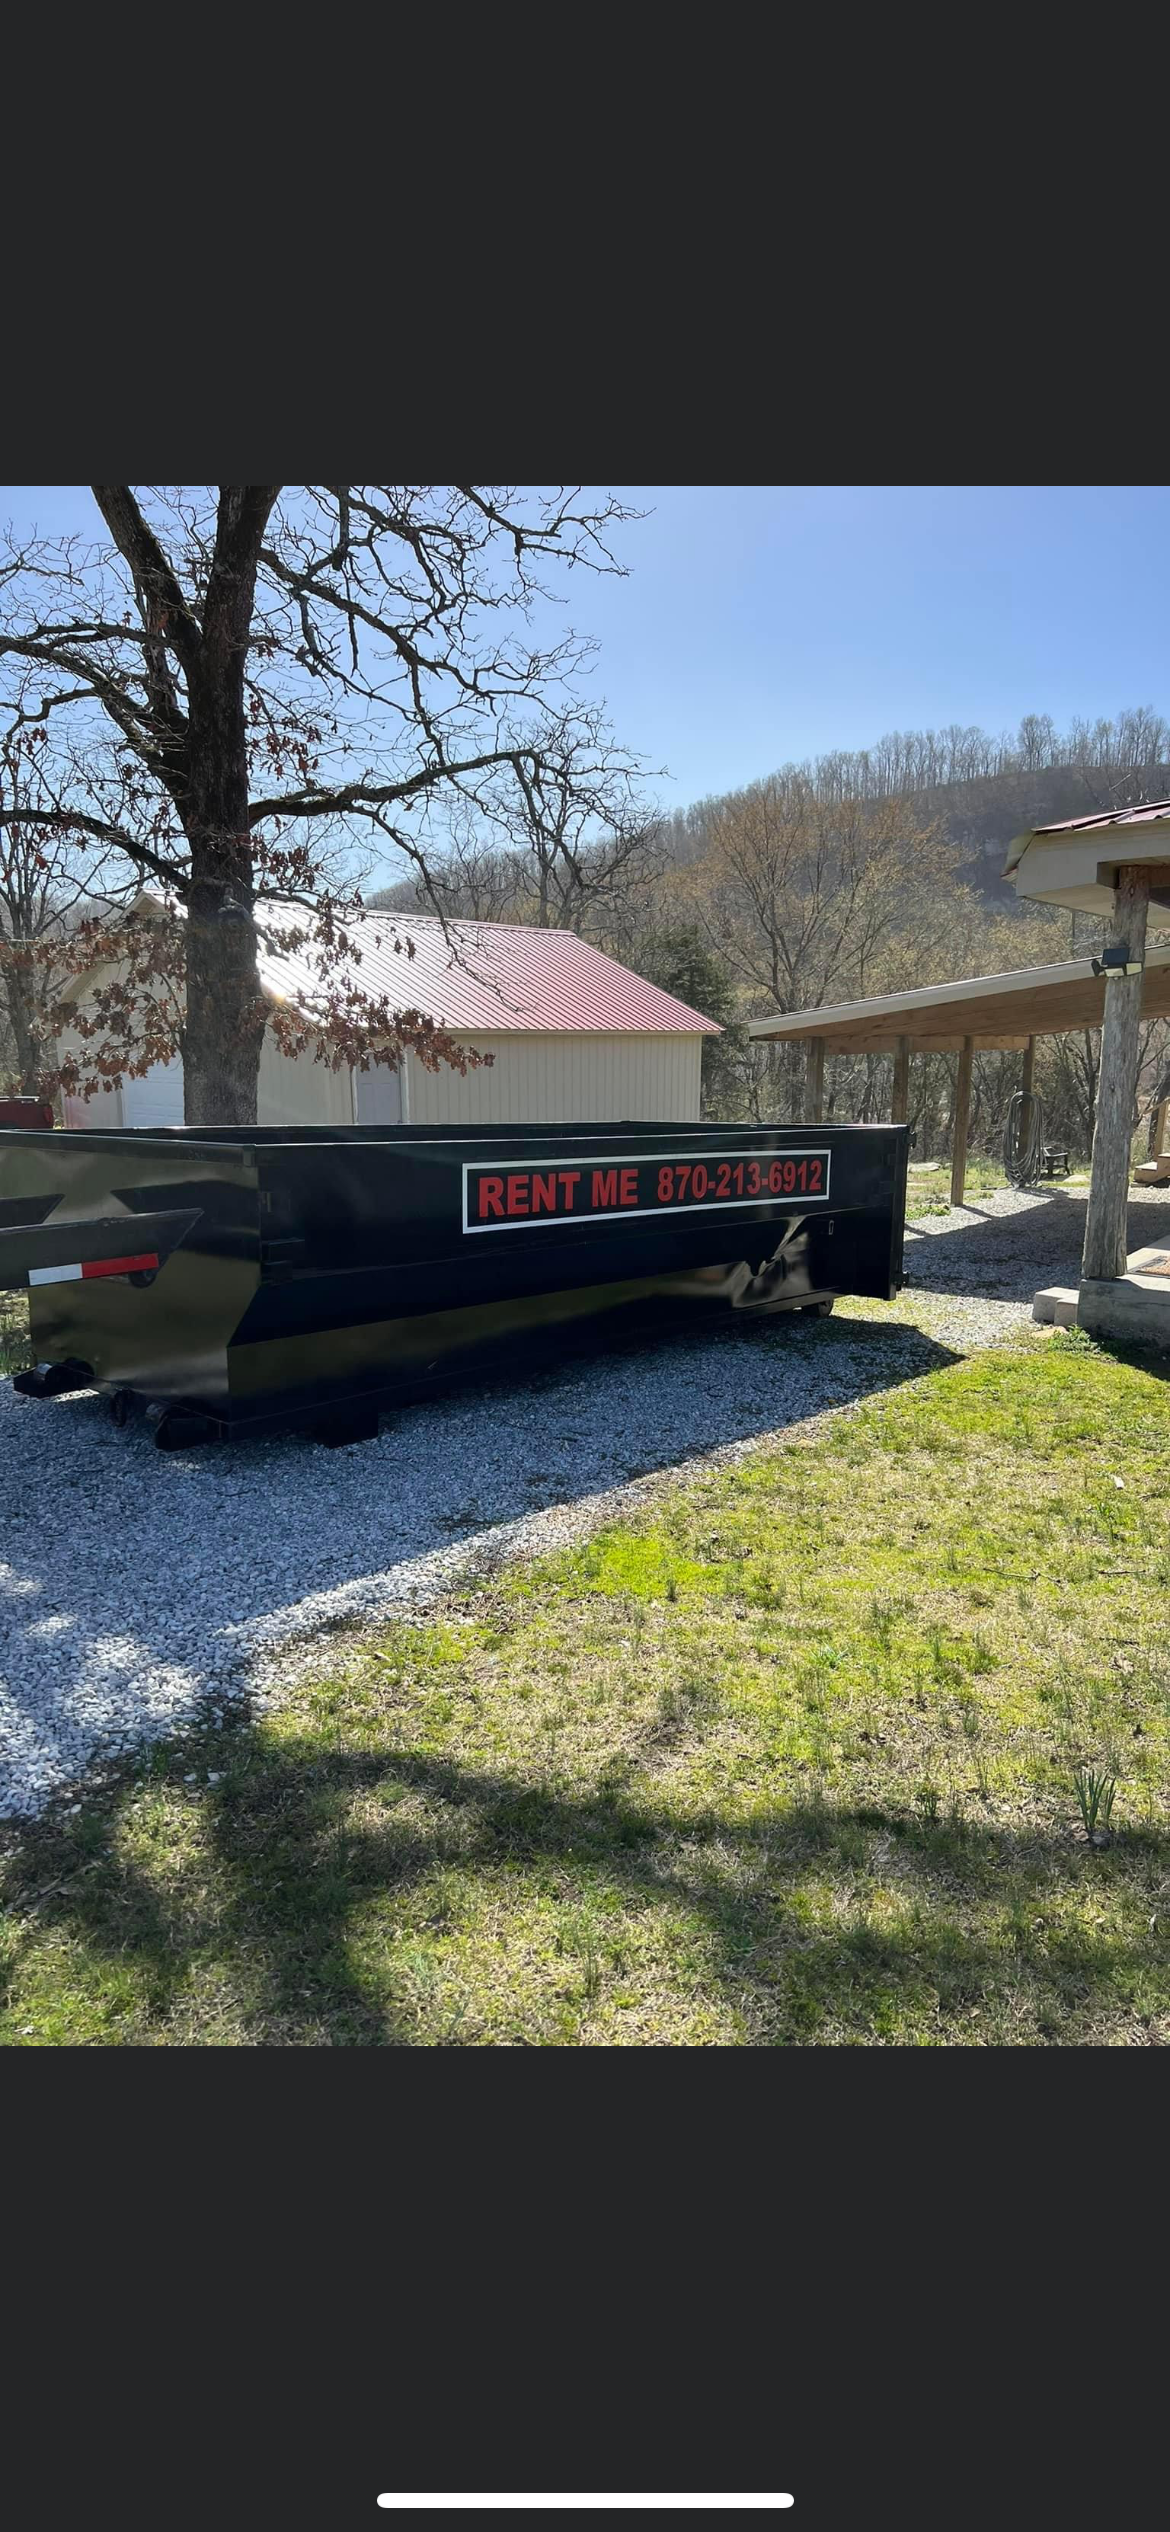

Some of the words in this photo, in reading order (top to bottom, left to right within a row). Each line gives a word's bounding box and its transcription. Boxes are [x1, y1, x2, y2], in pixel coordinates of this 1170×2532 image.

[478, 1172, 581, 1218] RENT
[592, 1169, 638, 1208] ME
[657, 1160, 822, 1202] 870-213-6912
